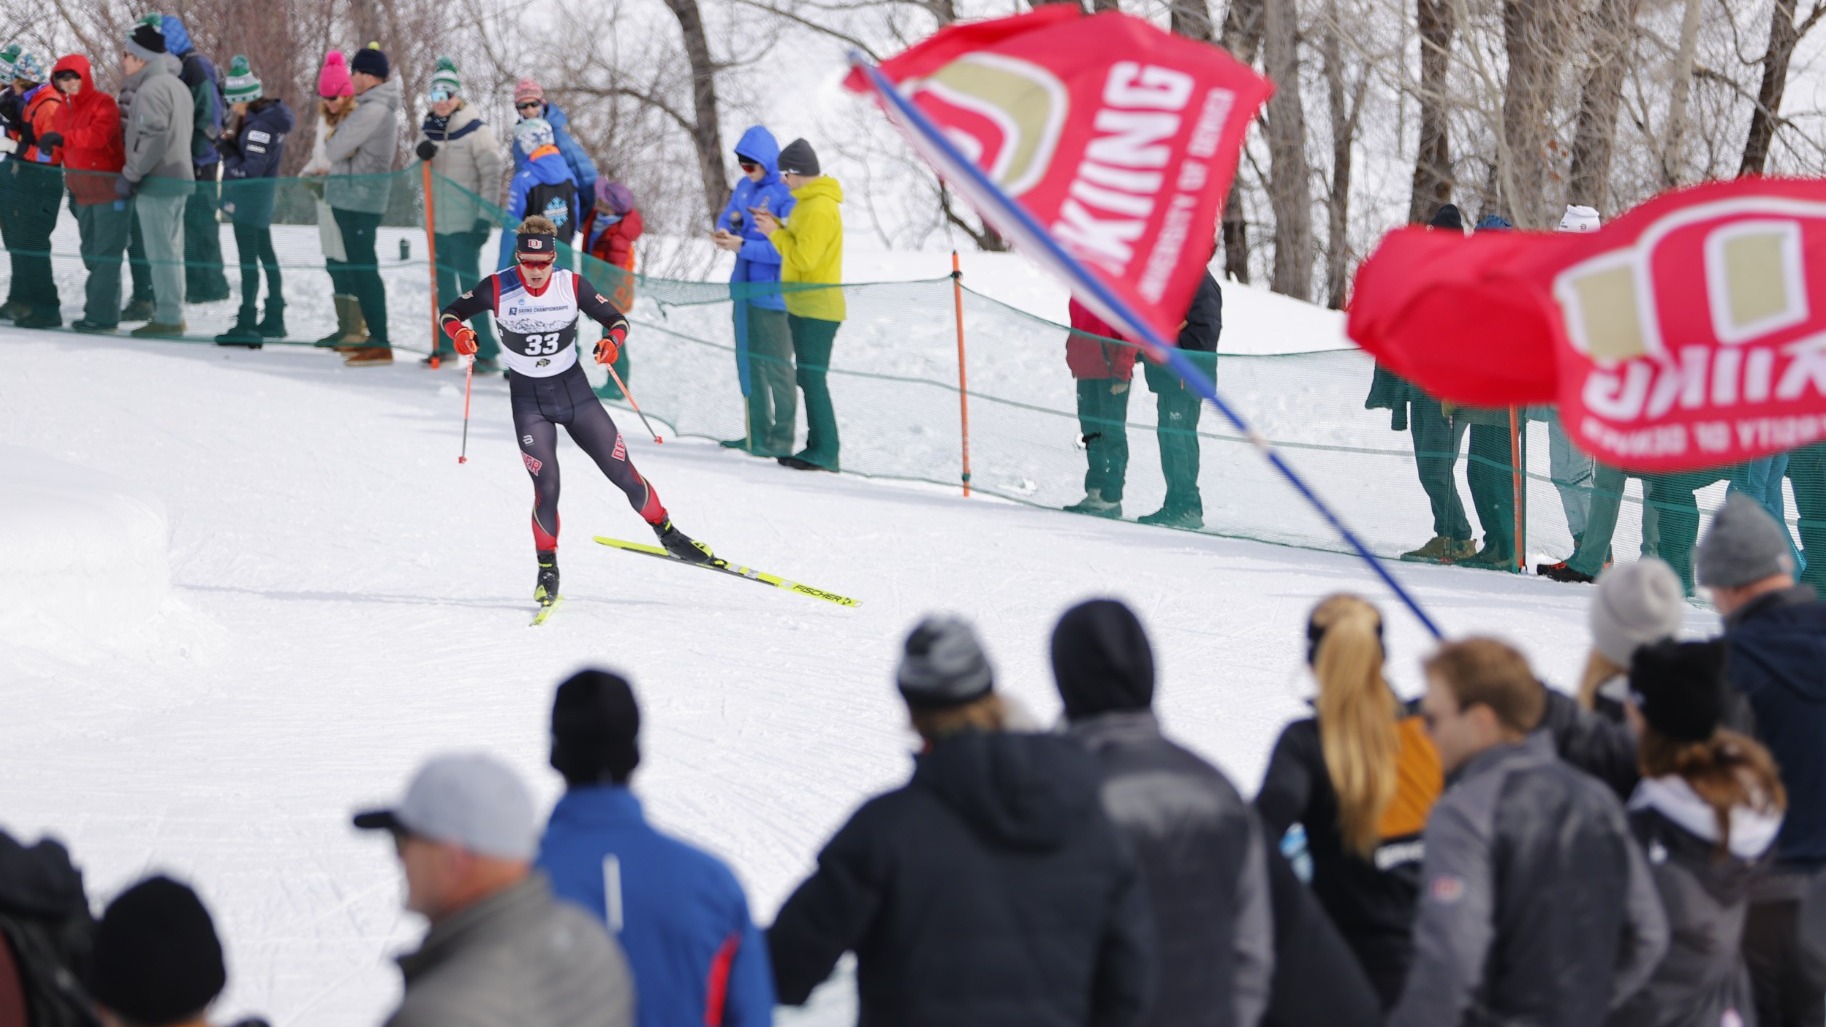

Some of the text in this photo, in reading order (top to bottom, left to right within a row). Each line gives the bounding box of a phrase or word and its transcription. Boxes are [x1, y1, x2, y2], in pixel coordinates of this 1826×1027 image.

[1050, 60, 1195, 276] KIING
[524, 332, 560, 355] 33
[793, 584, 843, 602] FISCHER
